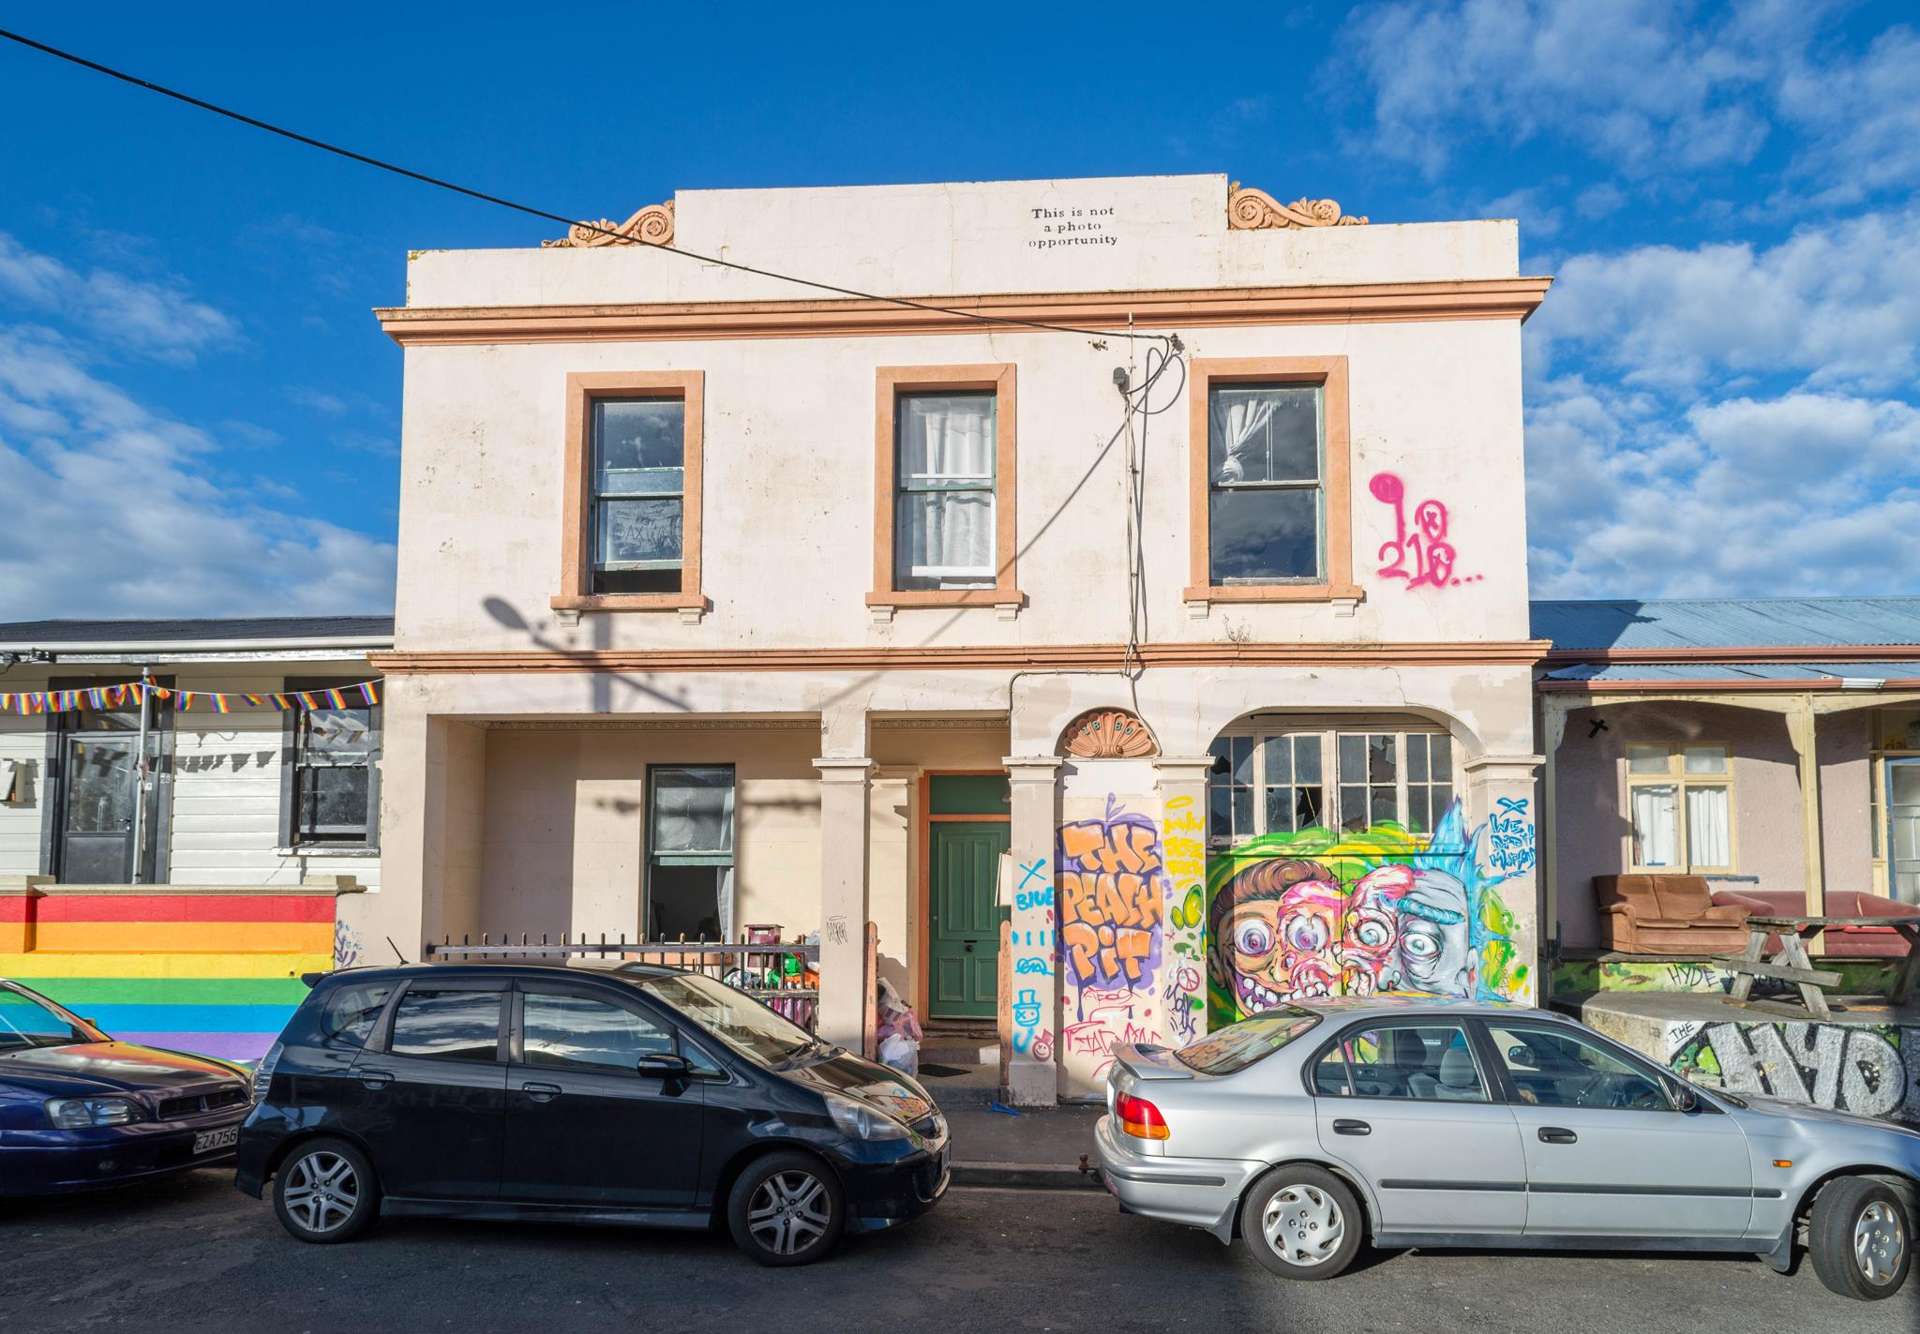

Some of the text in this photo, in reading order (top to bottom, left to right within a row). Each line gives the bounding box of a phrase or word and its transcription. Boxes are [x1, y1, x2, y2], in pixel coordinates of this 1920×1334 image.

[1031, 206, 1115, 219] This is not
[1057, 221, 1101, 234] photo
[1028, 234, 1118, 249] opportunity
[1058, 821, 1163, 874] THE
[1057, 870, 1164, 930] PEACH
[1667, 964, 1719, 988] HYDE
[1669, 1021, 1695, 1042] THE
[195, 1128, 237, 1151] EZA756
